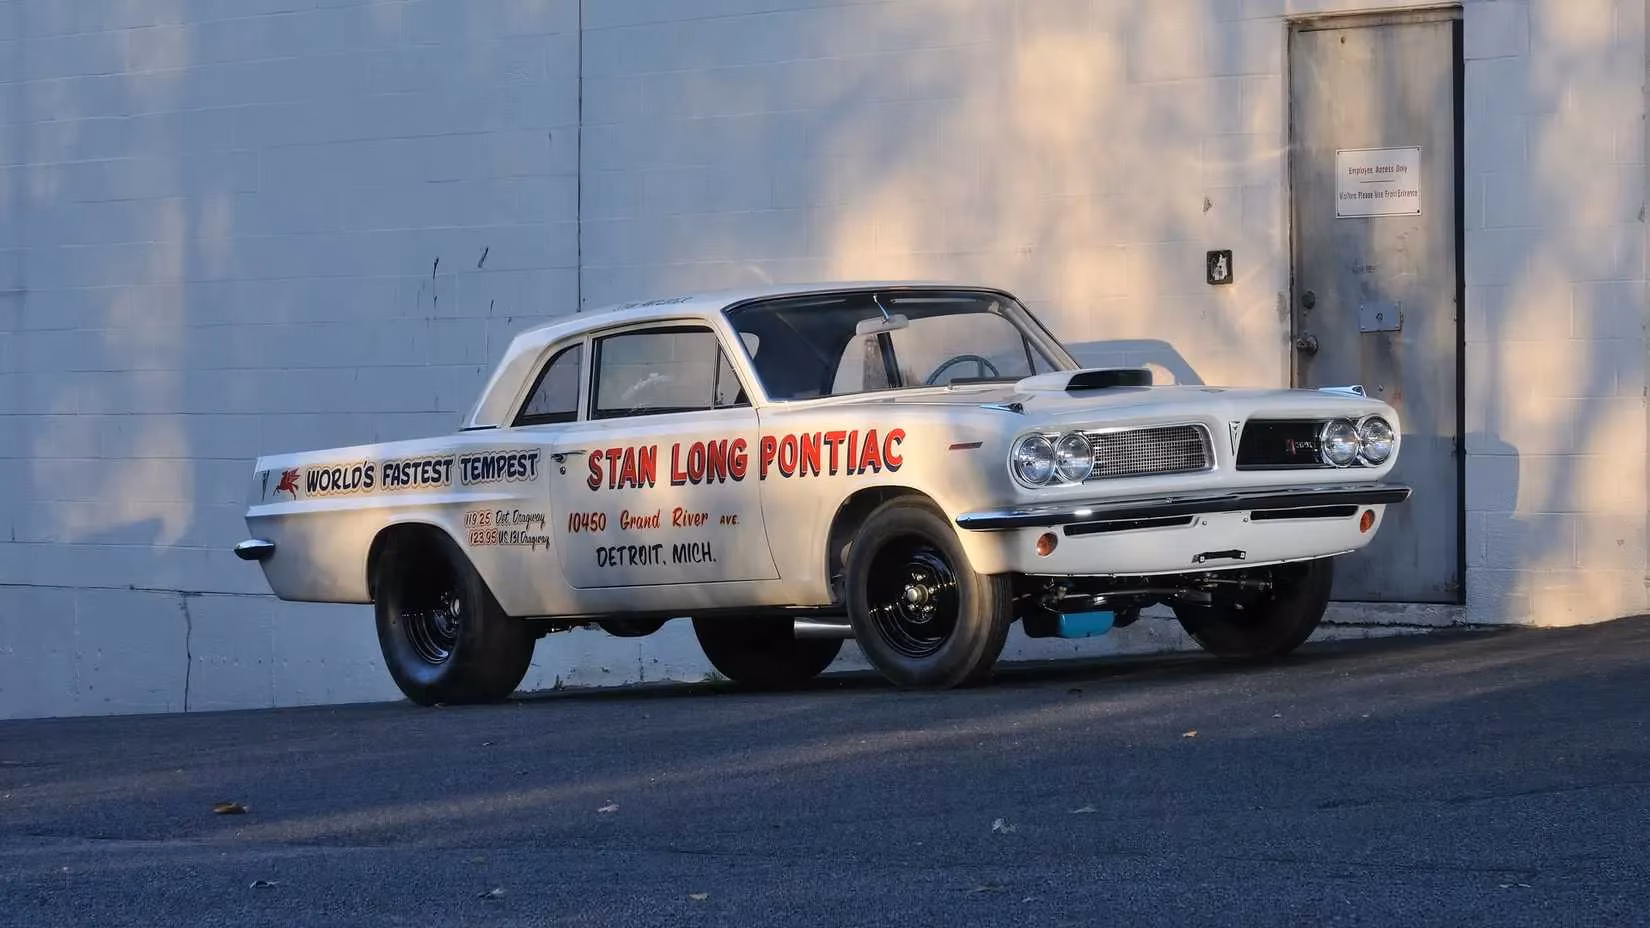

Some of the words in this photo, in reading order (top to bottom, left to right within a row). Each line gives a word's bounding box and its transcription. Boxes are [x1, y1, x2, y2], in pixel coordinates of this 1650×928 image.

[305, 460, 375, 493] WORLD'S
[381, 458, 454, 487] FASTEST
[460, 452, 538, 482] TEMPEST
[587, 445, 658, 491] STAN
[670, 438, 748, 486] LONG
[760, 428, 906, 481] PONTIAC
[568, 511, 607, 533] 10450
[620, 508, 661, 530] Grand
[672, 506, 709, 528] River
[672, 541, 717, 564] MICH.
